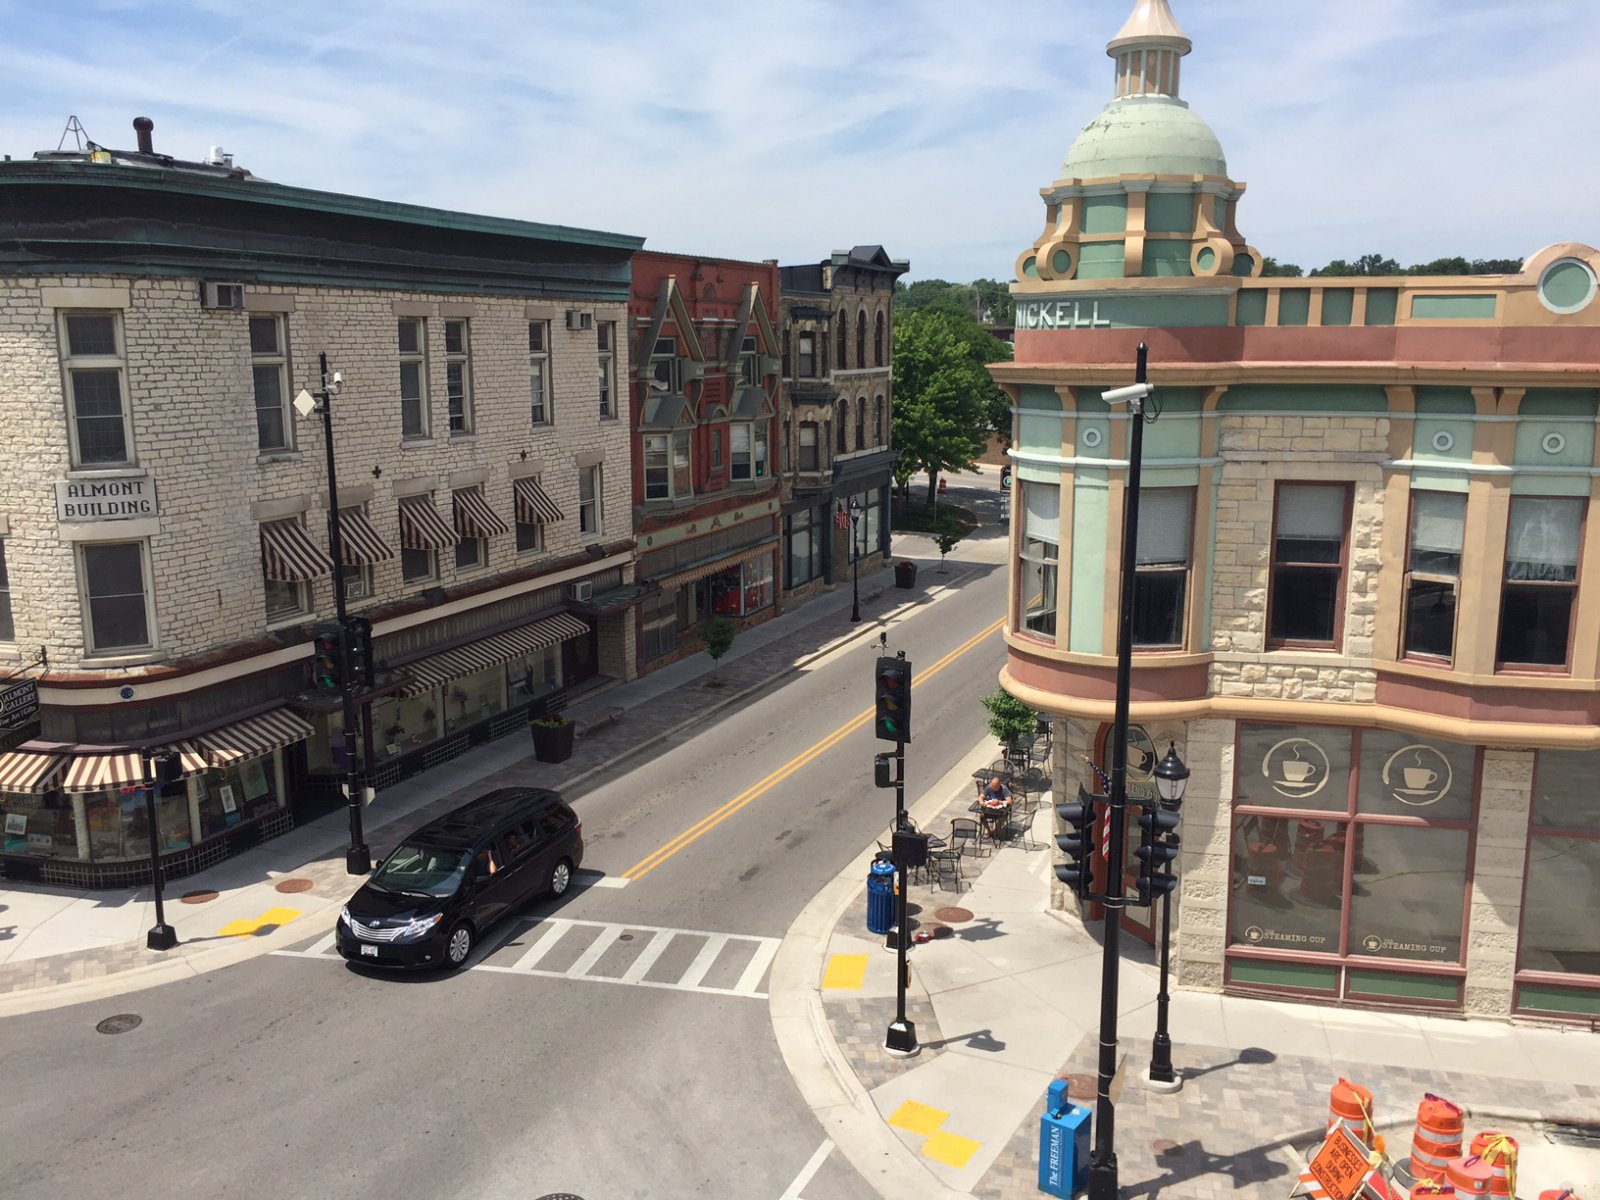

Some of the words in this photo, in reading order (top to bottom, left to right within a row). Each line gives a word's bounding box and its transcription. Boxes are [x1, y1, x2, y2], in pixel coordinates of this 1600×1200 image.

[68, 481, 144, 498] ALMONT
[64, 499, 151, 517] BUILDING
[4, 683, 34, 703] ALMONT
[5, 691, 36, 712] GALLERY
[1263, 932, 1307, 943] STEAMING
[1309, 936, 1327, 944] CUP
[1382, 941, 1427, 952] STEAMING
[1429, 945, 1447, 954] CUP
[1050, 1125, 1060, 1171] FREEMAN
[1334, 1135, 1363, 1173] BUSINESSES
[1325, 1160, 1345, 1184] DURING
[1329, 1148, 1342, 1164] ARE
[1340, 1159, 1355, 1180] OPEN
[1049, 1171, 1059, 1186] The
